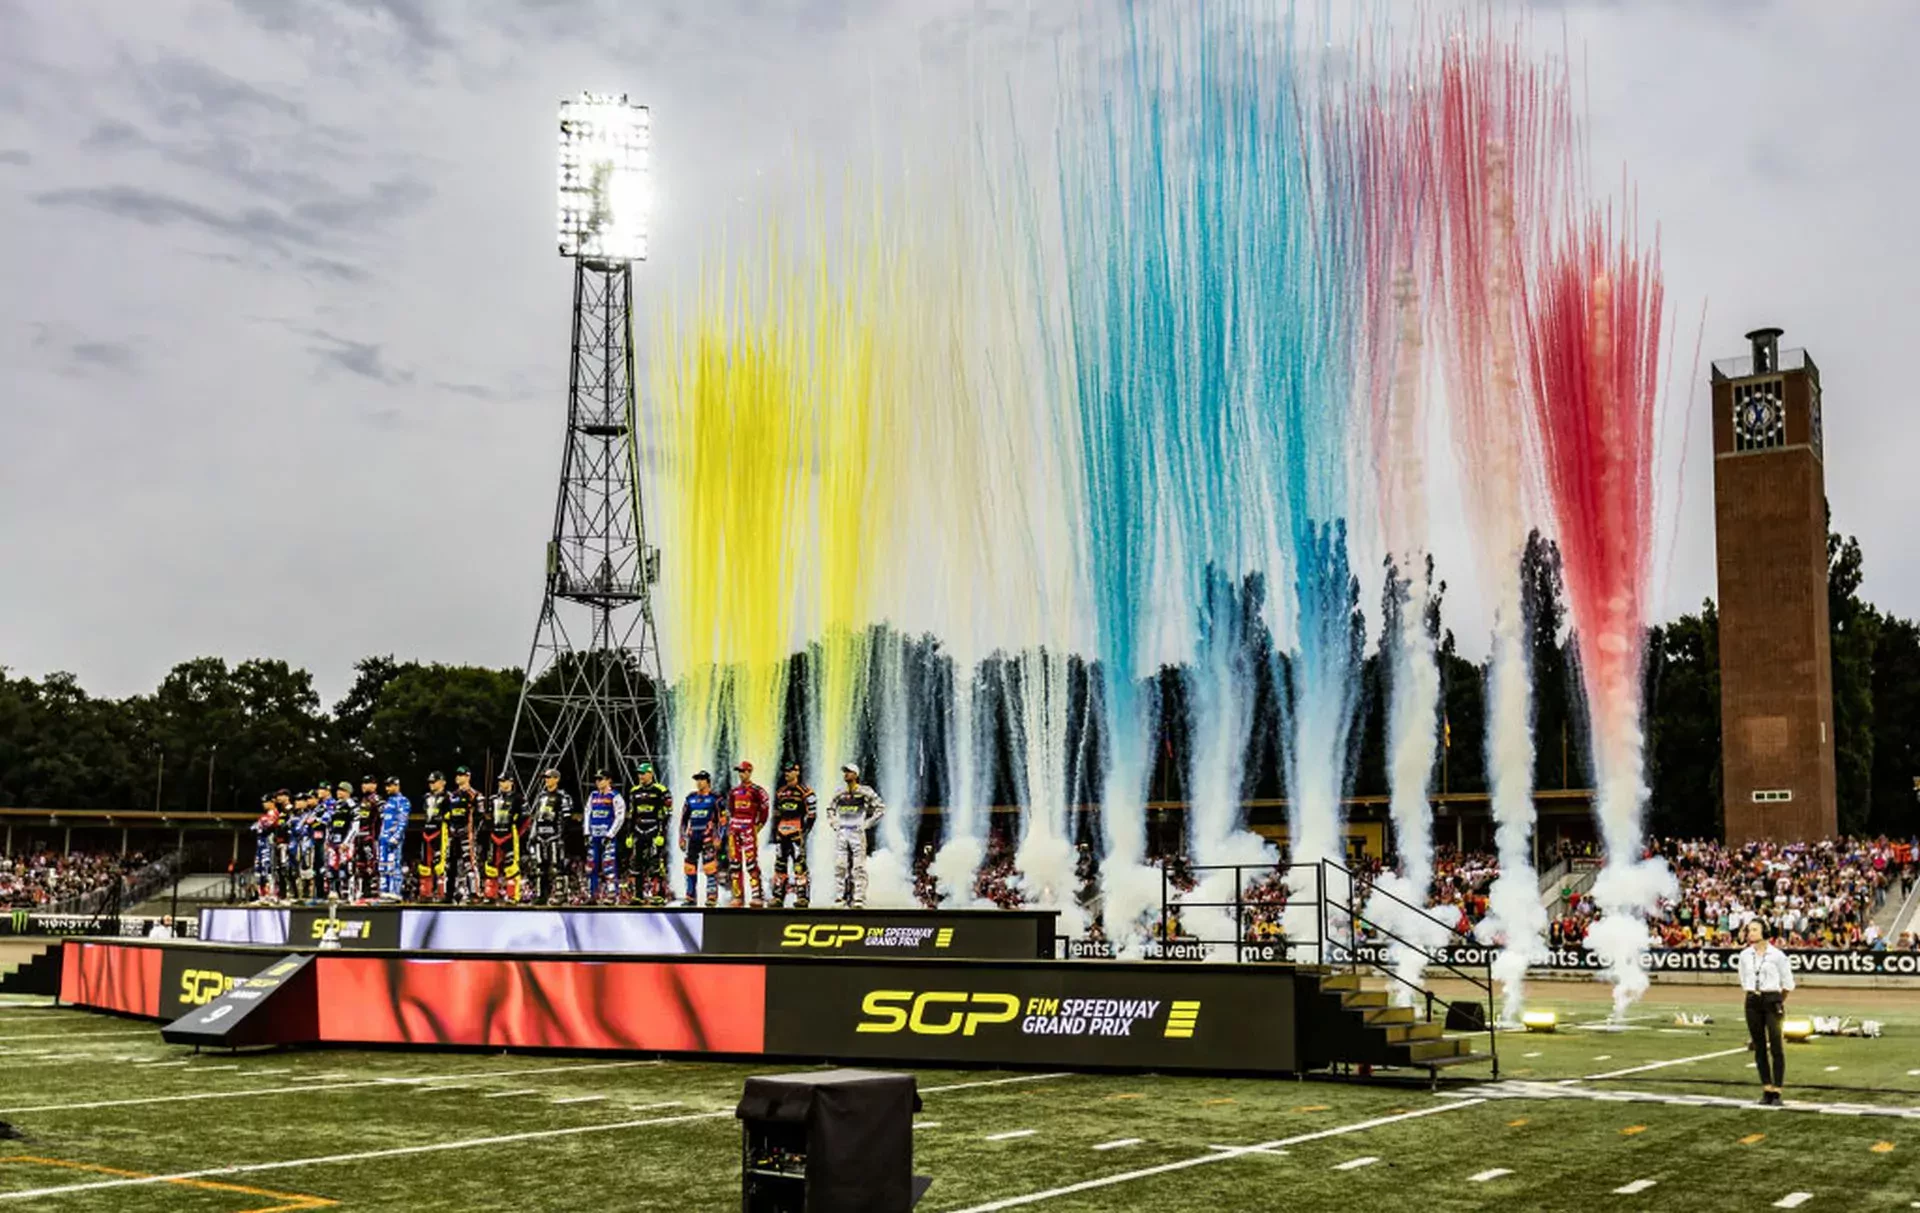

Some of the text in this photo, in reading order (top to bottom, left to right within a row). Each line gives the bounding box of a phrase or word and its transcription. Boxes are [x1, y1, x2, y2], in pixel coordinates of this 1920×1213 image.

[780, 923, 865, 948] SGP
[885, 928, 934, 939] SPEEDWAY
[1788, 951, 1920, 972] events.co
[178, 969, 224, 1005] SGP
[856, 990, 1021, 1036] SGP
[1026, 998, 1160, 1018] FIM SPEEDWAY
[1022, 1015, 1133, 1036] GRAND PRIX
